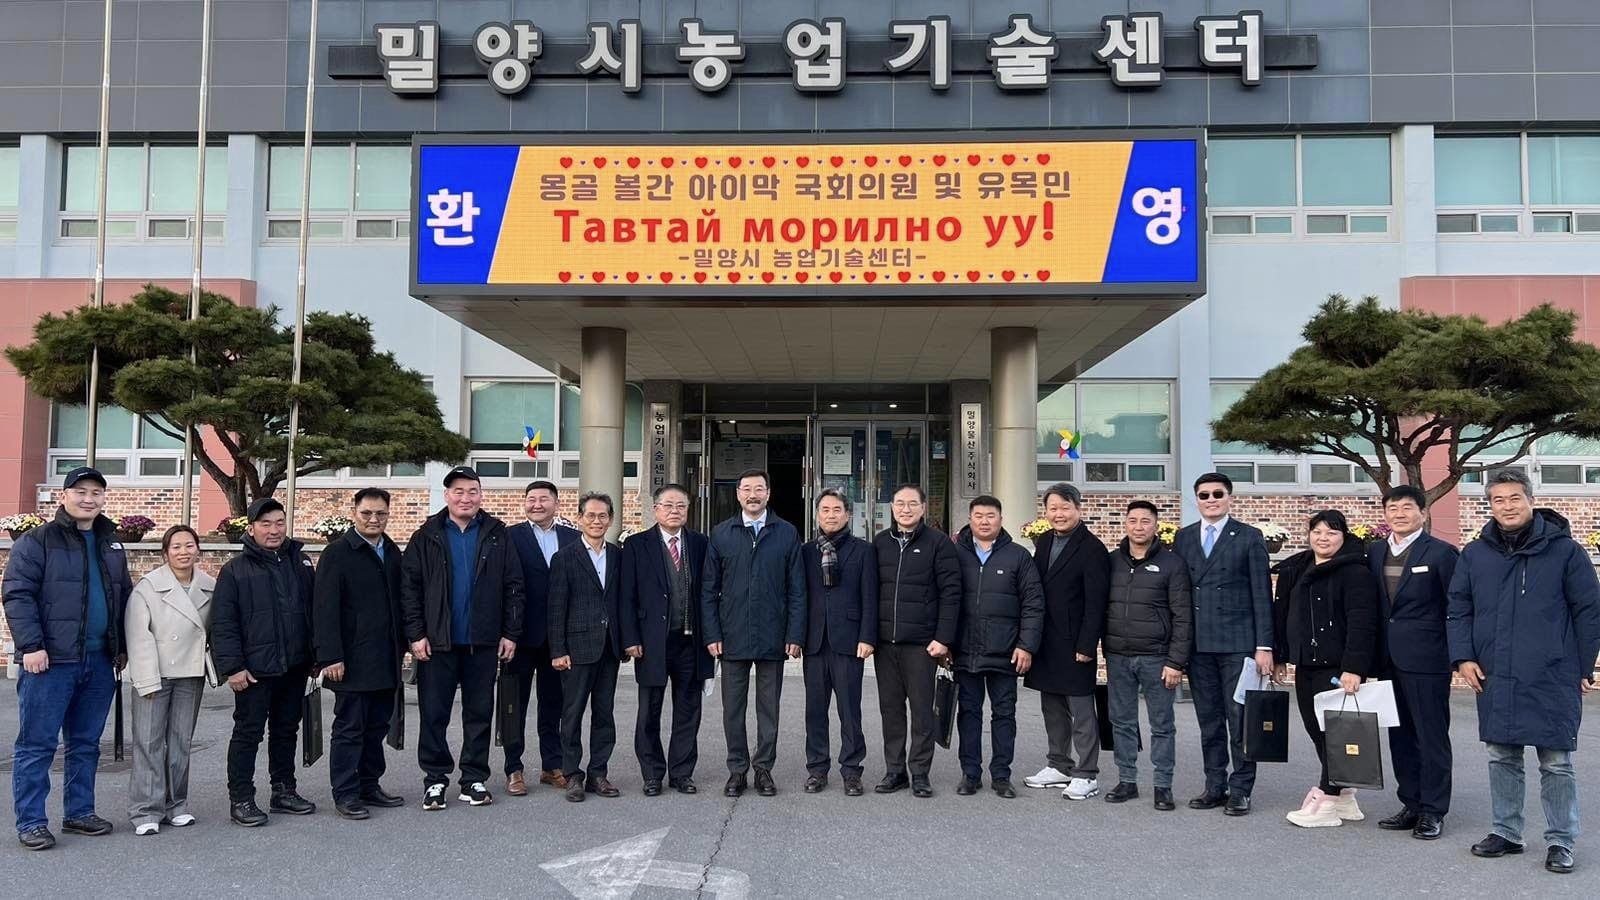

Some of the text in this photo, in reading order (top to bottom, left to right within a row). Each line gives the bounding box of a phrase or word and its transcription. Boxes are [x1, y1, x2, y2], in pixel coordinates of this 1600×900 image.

[374, 12, 1264, 93] 밀양시농업기술센터
[540, 171, 1071, 201] 몽골 볼간 아이막 국회의원 및 유목민
[426, 188, 481, 246] 환
[553, 201, 1054, 250] Тавтай морилно уу!
[1132, 187, 1182, 245] 영
[678, 247, 926, 268] -밀양시 농업기술센터-
[653, 411, 665, 487] 농업기술센터
